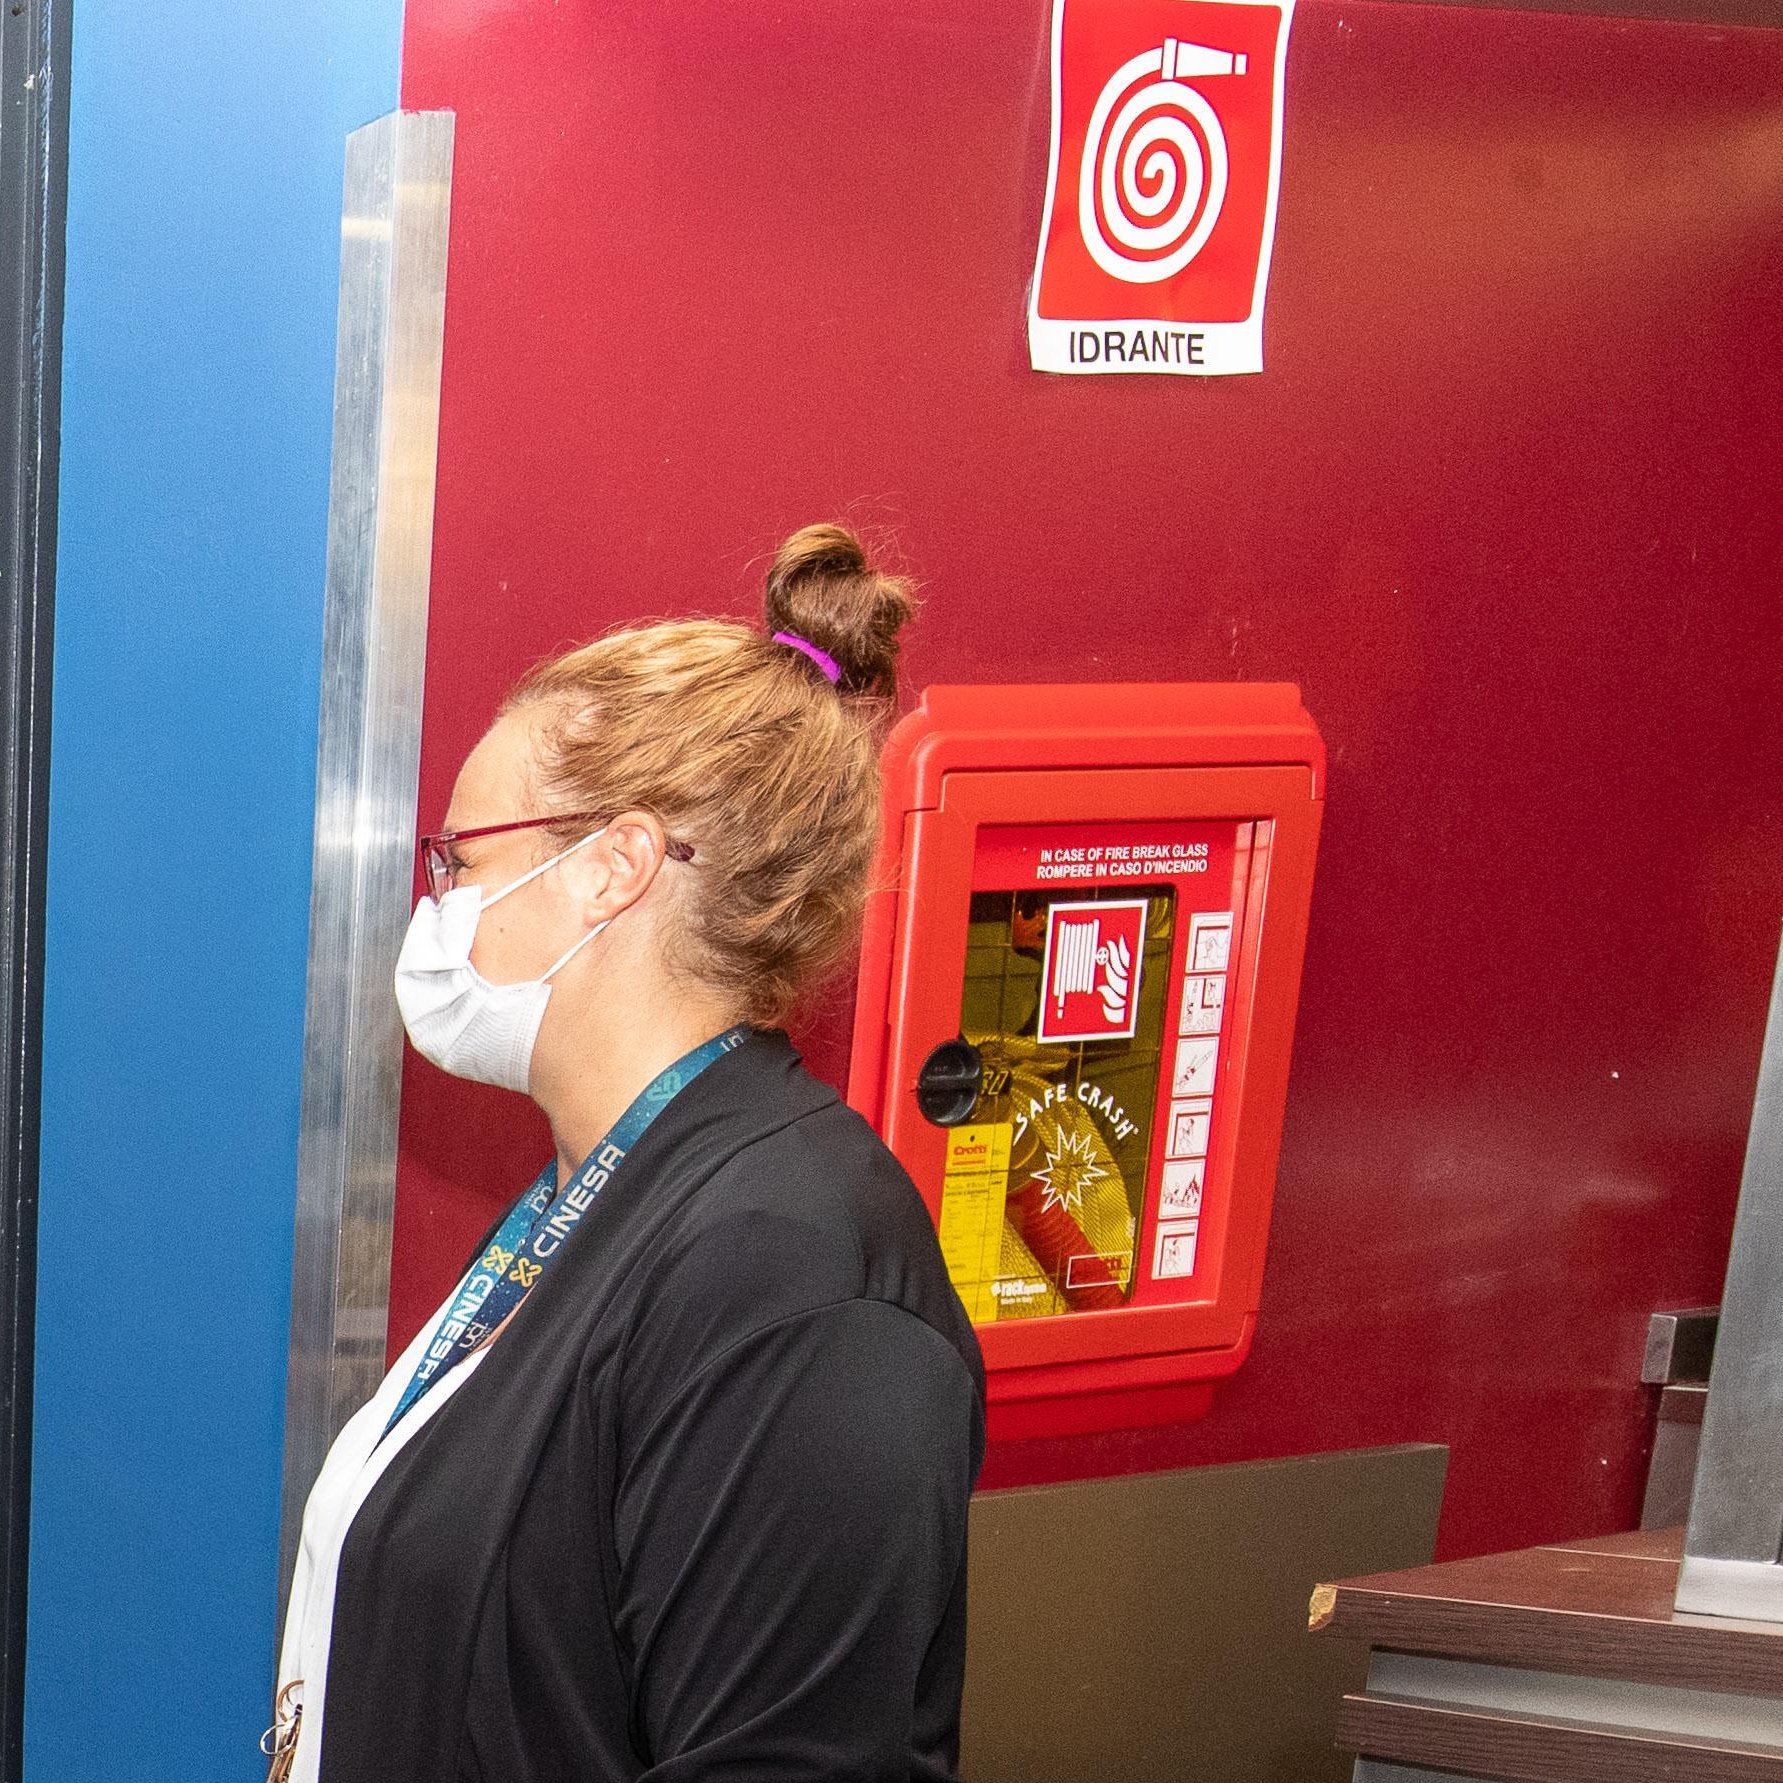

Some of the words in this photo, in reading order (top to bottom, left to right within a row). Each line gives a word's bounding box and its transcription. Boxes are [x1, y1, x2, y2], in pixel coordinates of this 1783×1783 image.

[1069, 330, 1205, 365] IDRANTE
[1036, 864, 1093, 879] ROMPERE
[1095, 862, 1108, 877] IN
[1109, 861, 1142, 876] CASO
[1143, 859, 1208, 874] D'INCENDIO
[1040, 849, 1052, 863] IN
[1054, 848, 1085, 862] CASE
[1087, 847, 1103, 861] OF
[1105, 846, 1129, 860] FIRE
[1132, 845, 1171, 859] BREAK
[1172, 843, 1209, 857] GLASS
[1013, 1083, 1068, 1146] SAFE
[1077, 1082, 1134, 1141] CRASH
[533, 1143, 625, 1258] CINESA
[417, 1274, 495, 1381] CINESA
